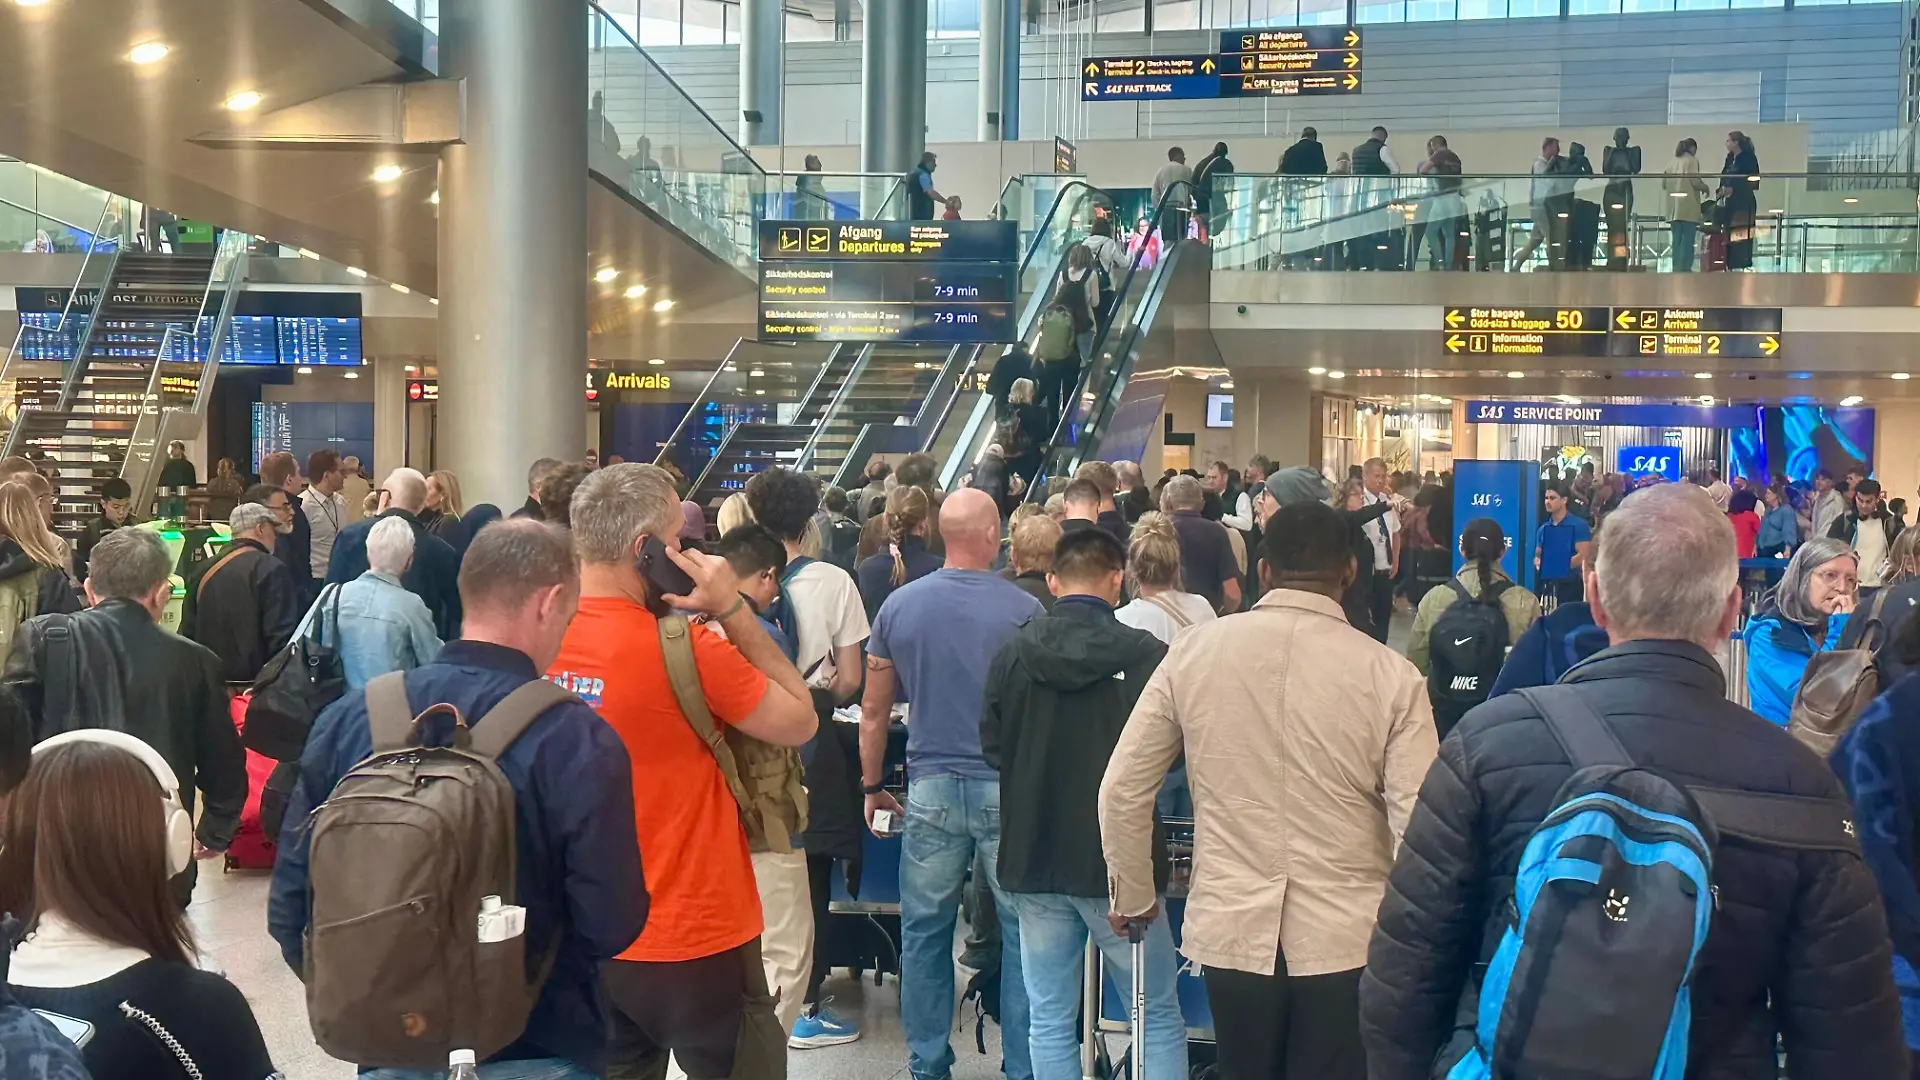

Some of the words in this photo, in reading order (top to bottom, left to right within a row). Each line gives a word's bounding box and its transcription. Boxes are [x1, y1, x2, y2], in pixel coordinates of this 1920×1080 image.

[1259, 41, 1268, 49] All
[1269, 41, 1308, 49] departures
[1103, 60, 1133, 68] Terminal
[1135, 60, 1145, 75] 2
[1259, 62, 1287, 70] Security
[1287, 60, 1312, 68] control
[1104, 68, 1133, 76] Terminal
[1254, 79, 1269, 87] CPH
[1270, 79, 1299, 87] Express
[1104, 84, 1123, 94] SAS
[1124, 84, 1144, 93] FAST
[1146, 84, 1172, 92] TRACK
[839, 226, 882, 240] Afgang
[839, 240, 905, 254] Departures
[765, 270, 833, 279] Sikkerhedskontrol
[765, 286, 796, 295] Security
[798, 286, 826, 294] control
[934, 285, 954, 297] 7-9
[957, 285, 979, 297] min
[879, 311, 885, 319] 2
[934, 312, 954, 324] 7-9
[957, 312, 978, 324] min
[1470, 308, 1490, 318] Stor
[1491, 308, 1525, 319] bagage
[1664, 309, 1704, 319] Ankomst
[1470, 319, 1509, 328] Odd-size
[1511, 319, 1551, 330] baggage
[1556, 310, 1583, 329] 50
[1664, 319, 1698, 329] Arrivals
[765, 324, 795, 334] Security
[796, 325, 822, 333] control
[1492, 333, 1544, 343] Information
[1492, 344, 1543, 353] Information
[1663, 344, 1702, 354] Terminal
[1664, 334, 1702, 344] Terminal
[1707, 335, 1721, 354] 2
[606, 372, 671, 389] Arrivals
[1477, 405, 1506, 419] SAS
[1513, 407, 1564, 420] SERVICE
[1565, 408, 1602, 421] POINT
[1629, 455, 1671, 472] SAS
[1471, 493, 1492, 506] SAS
[1450, 675, 1479, 690] NIKE
